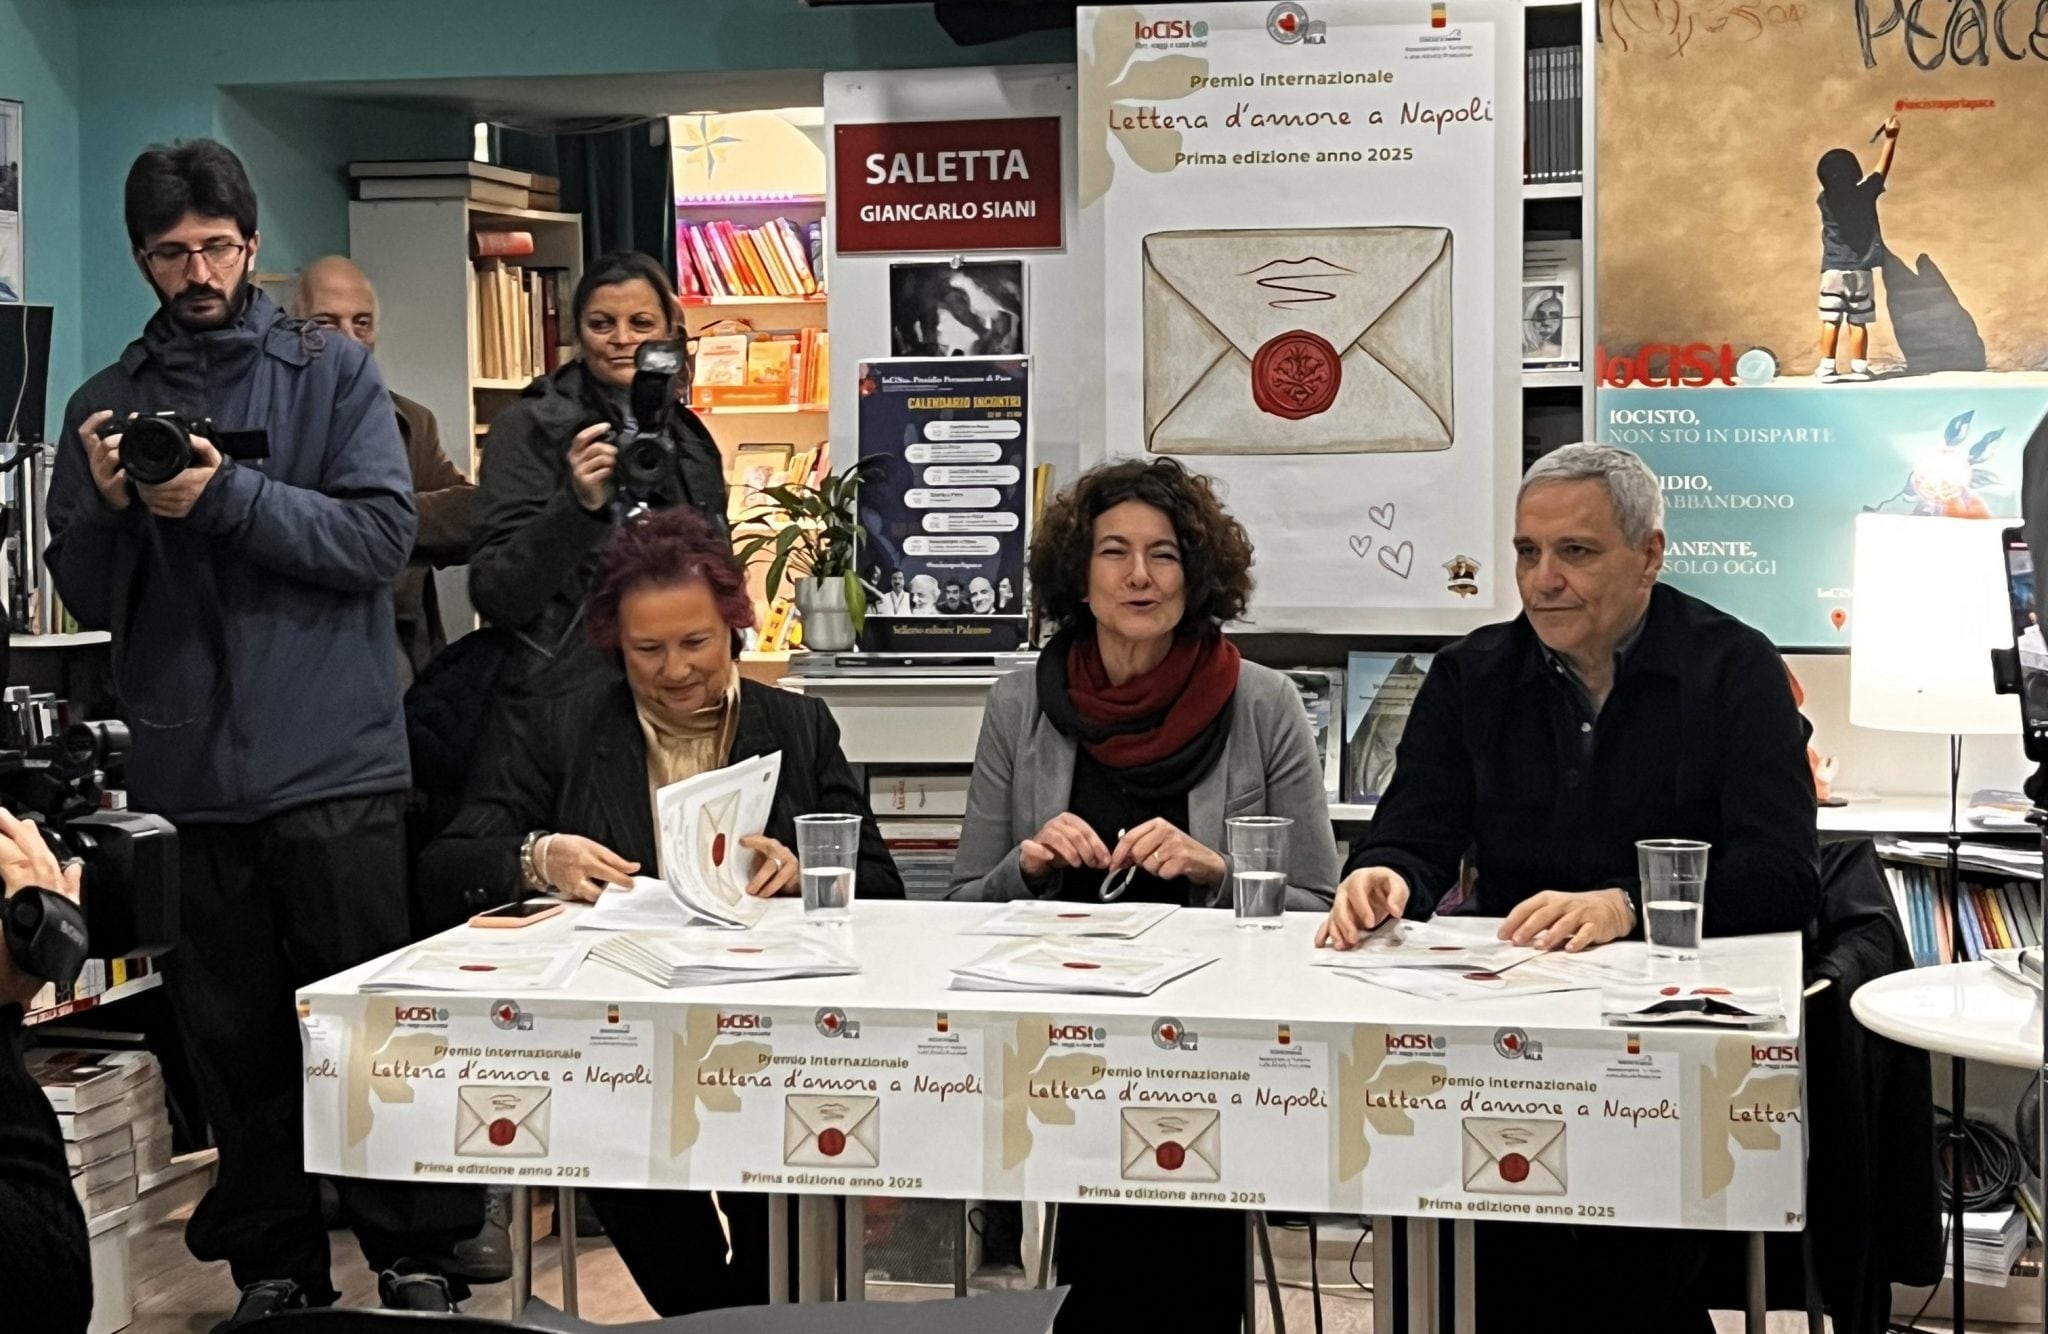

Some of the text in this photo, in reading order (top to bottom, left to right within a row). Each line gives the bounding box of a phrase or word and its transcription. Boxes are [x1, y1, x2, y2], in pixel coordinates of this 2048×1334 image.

[1190, 70, 1394, 88] Premio Internazionale
[1109, 96, 1493, 135] Lettera d'amore a Napoli
[1175, 148, 1413, 166] Prima edizione anno 2025
[866, 149, 1029, 185] SALETTA
[860, 200, 1036, 222] GIANCARLO SIANI
[1610, 409, 1700, 426] IOCISTO,
[1609, 428, 1835, 443] NON STO IN DISPARTE
[1663, 541, 1757, 558] ANENTE,
[1724, 560, 1777, 575] OGGI
[810, 1055, 909, 1069] Internazionale
[371, 1060, 652, 1092] Lettera d'amore a Napoli
[1091, 1065, 1250, 1081] Premio Internazionale
[697, 1068, 983, 1102] Lettera d'amore a Napoli
[1432, 1074, 1597, 1093] Premio Internazionale
[1028, 1080, 1328, 1116] Lettera d'amore a Napoli
[1365, 1089, 1680, 1128] Lettera d'amore a Napoli
[414, 1161, 590, 1178] Prima edizione anno 2025
[742, 1170, 923, 1188] Prima edizione anno 2025
[1079, 1185, 1266, 1204] Prima edizione anno 2025
[1418, 1197, 1615, 1218] Prima edizione anno 2025
